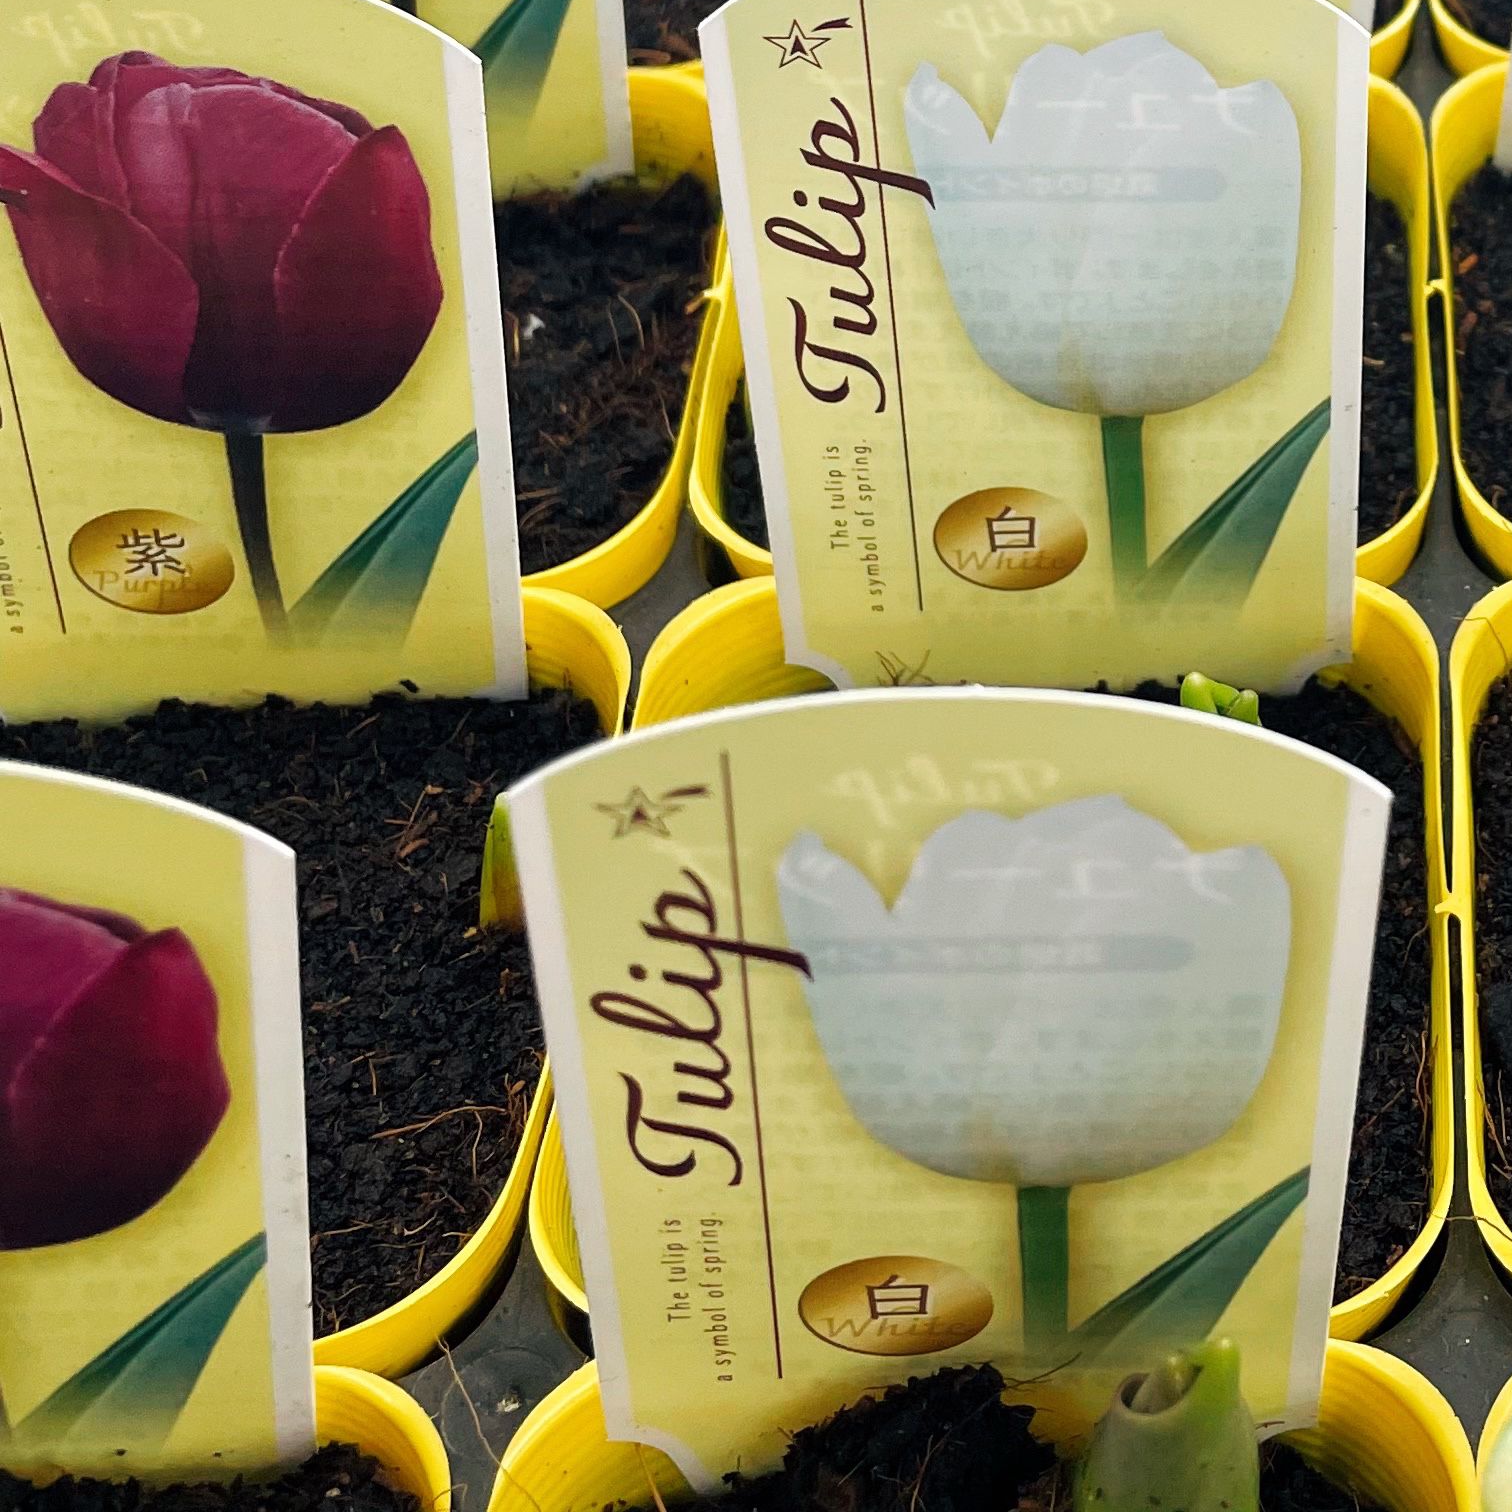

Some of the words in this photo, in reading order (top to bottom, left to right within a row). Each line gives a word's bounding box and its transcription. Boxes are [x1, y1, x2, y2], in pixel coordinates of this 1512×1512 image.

[764, 96, 937, 414] Tulip
[822, 446, 840, 460] is
[824, 469, 847, 510] tulip
[829, 519, 850, 550] The
[854, 510, 875, 527] of
[985, 505, 1036, 553] 白
[116, 527, 185, 577] 紫
[856, 536, 887, 596] symbol
[871, 604, 884, 612] a
[589, 868, 814, 1188] Tulip
[658, 1219, 681, 1233] is
[697, 1212, 727, 1273] spring.
[661, 1243, 689, 1282] tulip
[666, 1292, 692, 1322] The
[699, 1283, 724, 1298] of
[865, 1274, 930, 1320] 白
[702, 1308, 736, 1367] symbol
[717, 1374, 733, 1382] a
